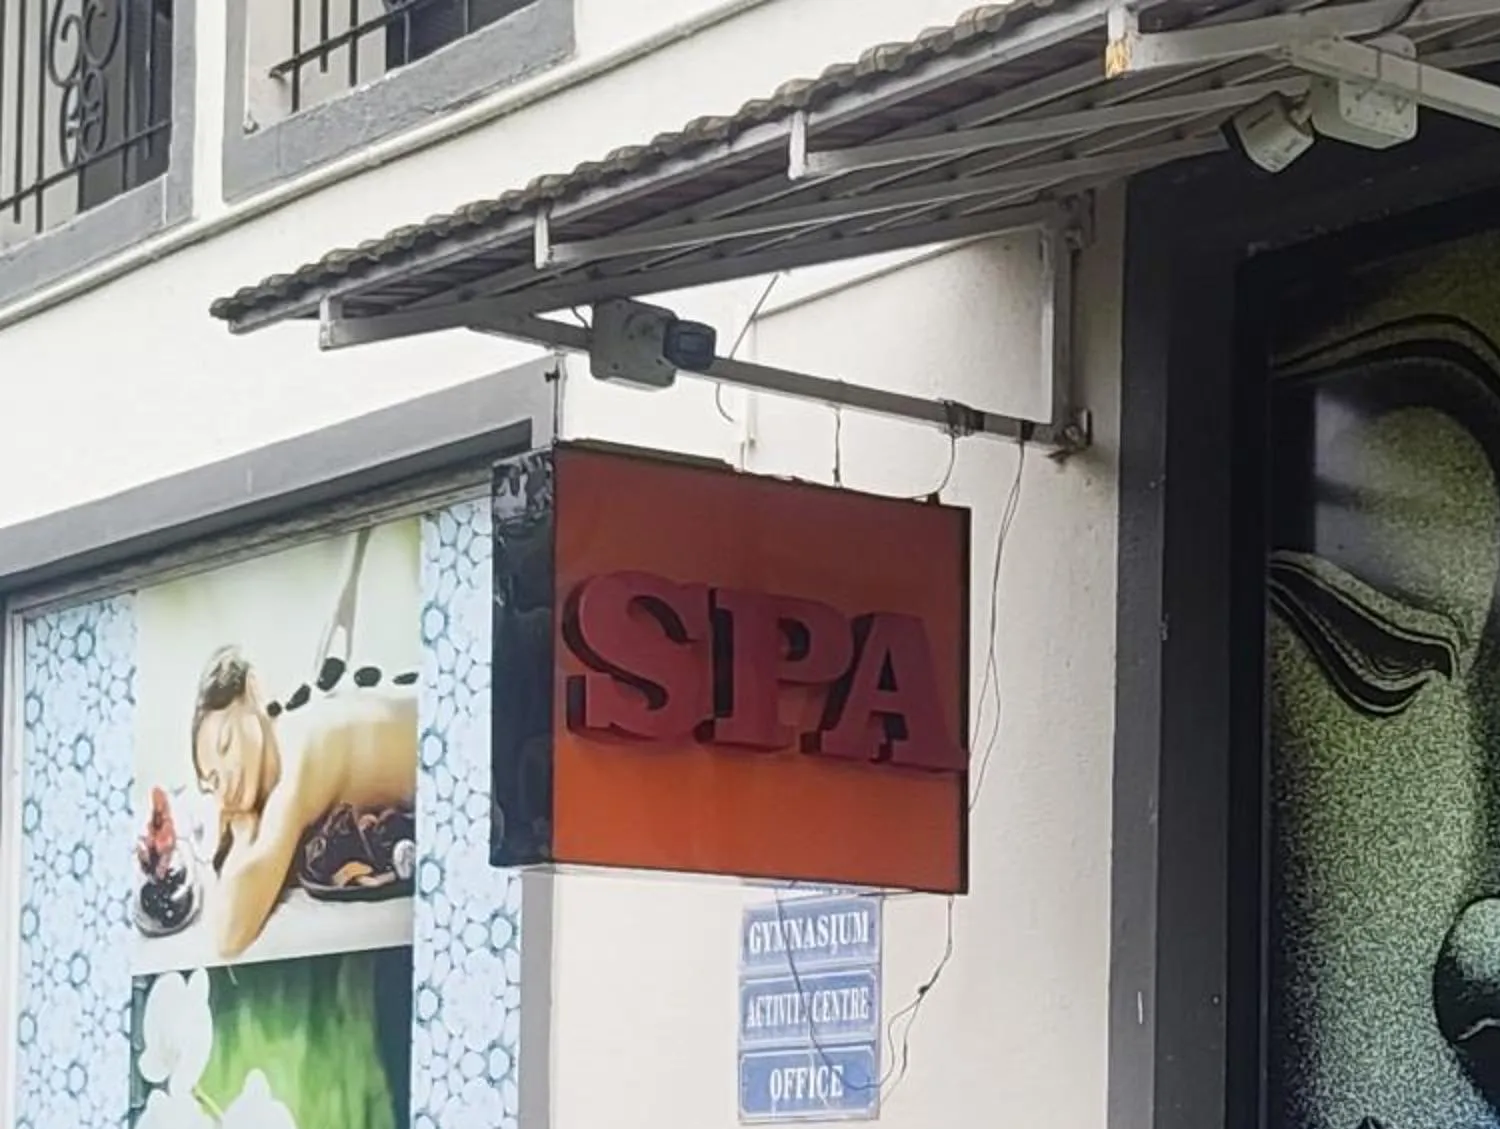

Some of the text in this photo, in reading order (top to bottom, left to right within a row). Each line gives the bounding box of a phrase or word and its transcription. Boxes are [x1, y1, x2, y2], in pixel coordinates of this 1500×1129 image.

[563, 569, 967, 772] SPA
[811, 986, 871, 1022] CENTRE
[769, 1065, 844, 1101] OFFICE
